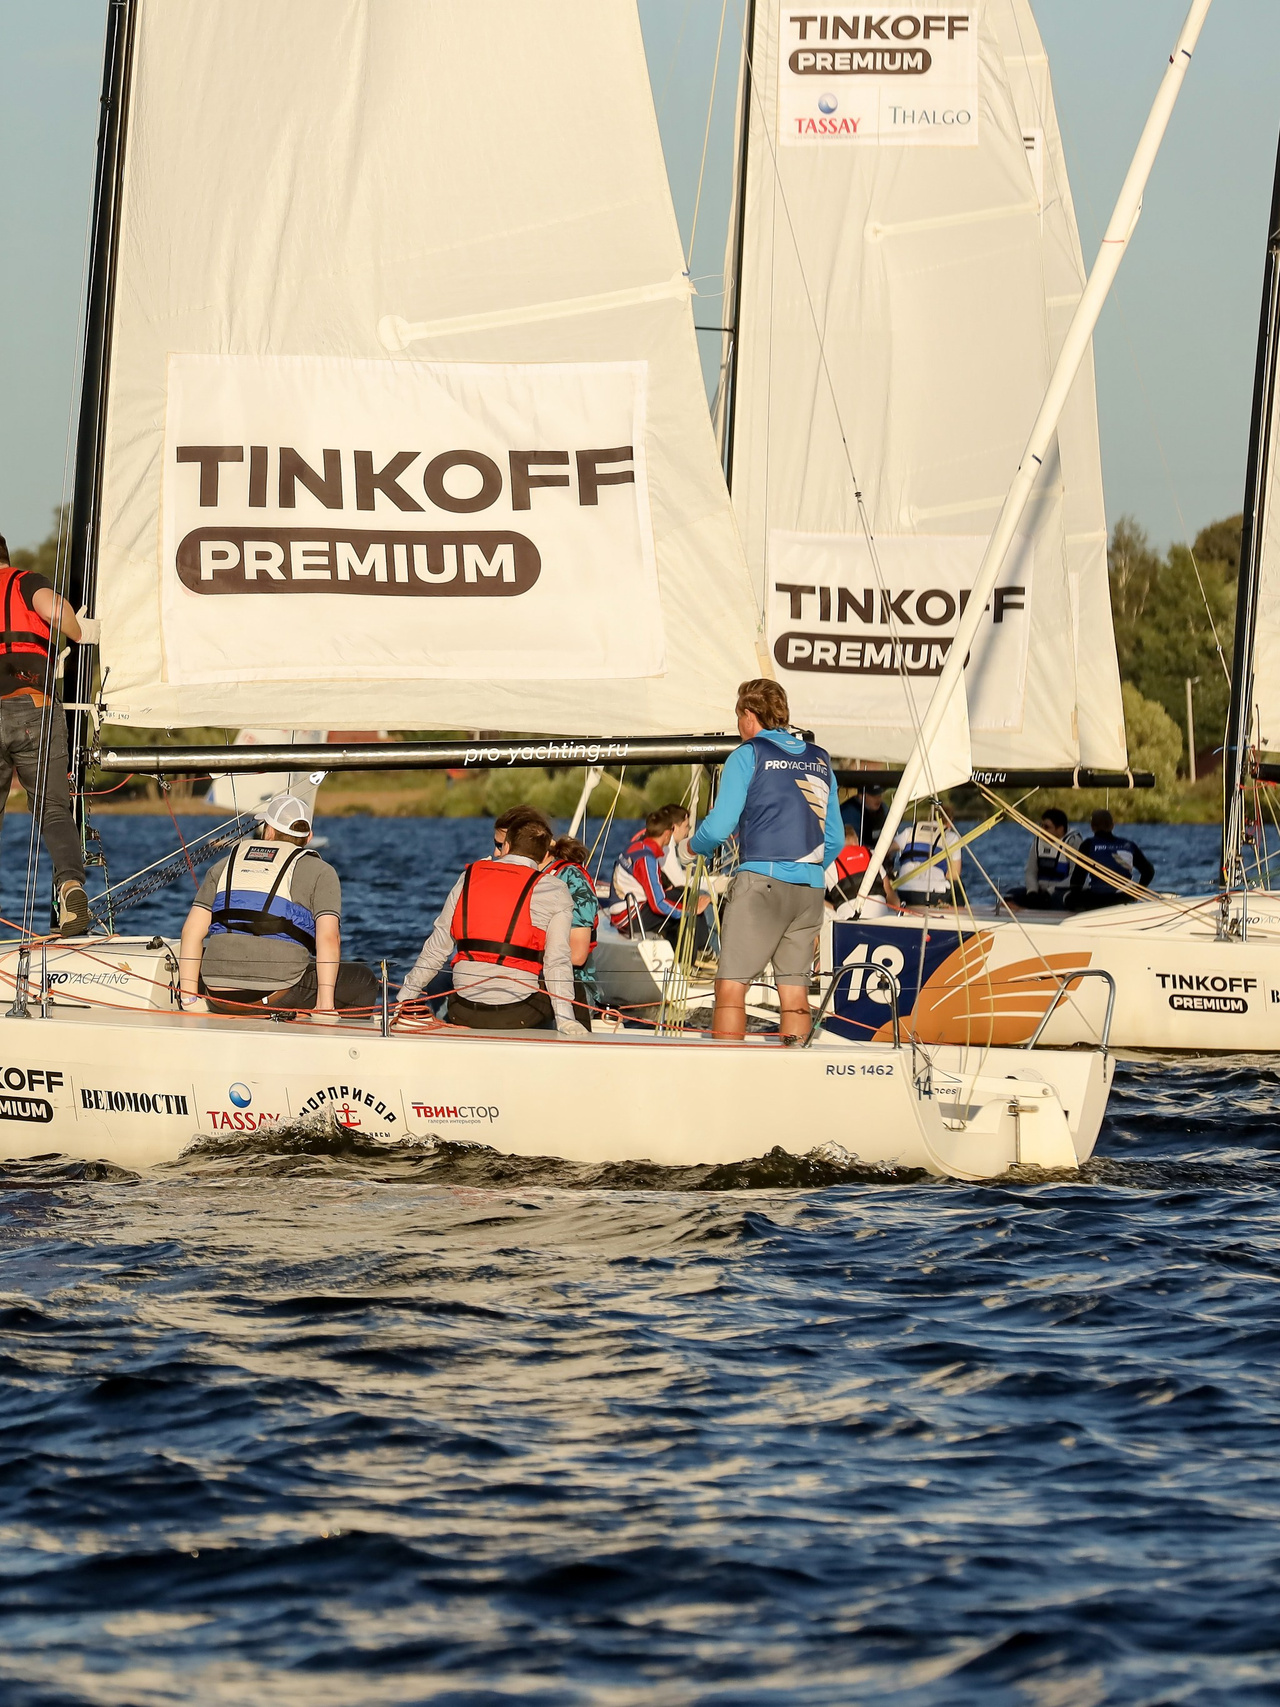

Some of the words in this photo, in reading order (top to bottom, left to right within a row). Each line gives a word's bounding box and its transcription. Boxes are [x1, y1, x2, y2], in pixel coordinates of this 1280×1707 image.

[789, 15, 969, 40] TINKOFF
[798, 51, 923, 71] PREMIUM
[794, 117, 861, 134] TASSAY
[176, 445, 634, 513] TINKOFF
[199, 540, 516, 583] PREMIUM
[464, 741, 629, 766] pro-yachting.ru
[842, 943, 904, 1004] 18
[1156, 973, 1257, 993] TINKOFF
[1173, 996, 1243, 1012] PREMIUM
[826, 1064, 856, 1076] RUS
[860, 1064, 894, 1076] 1462
[80, 1088, 189, 1115] ВЕДОМОСТИ
